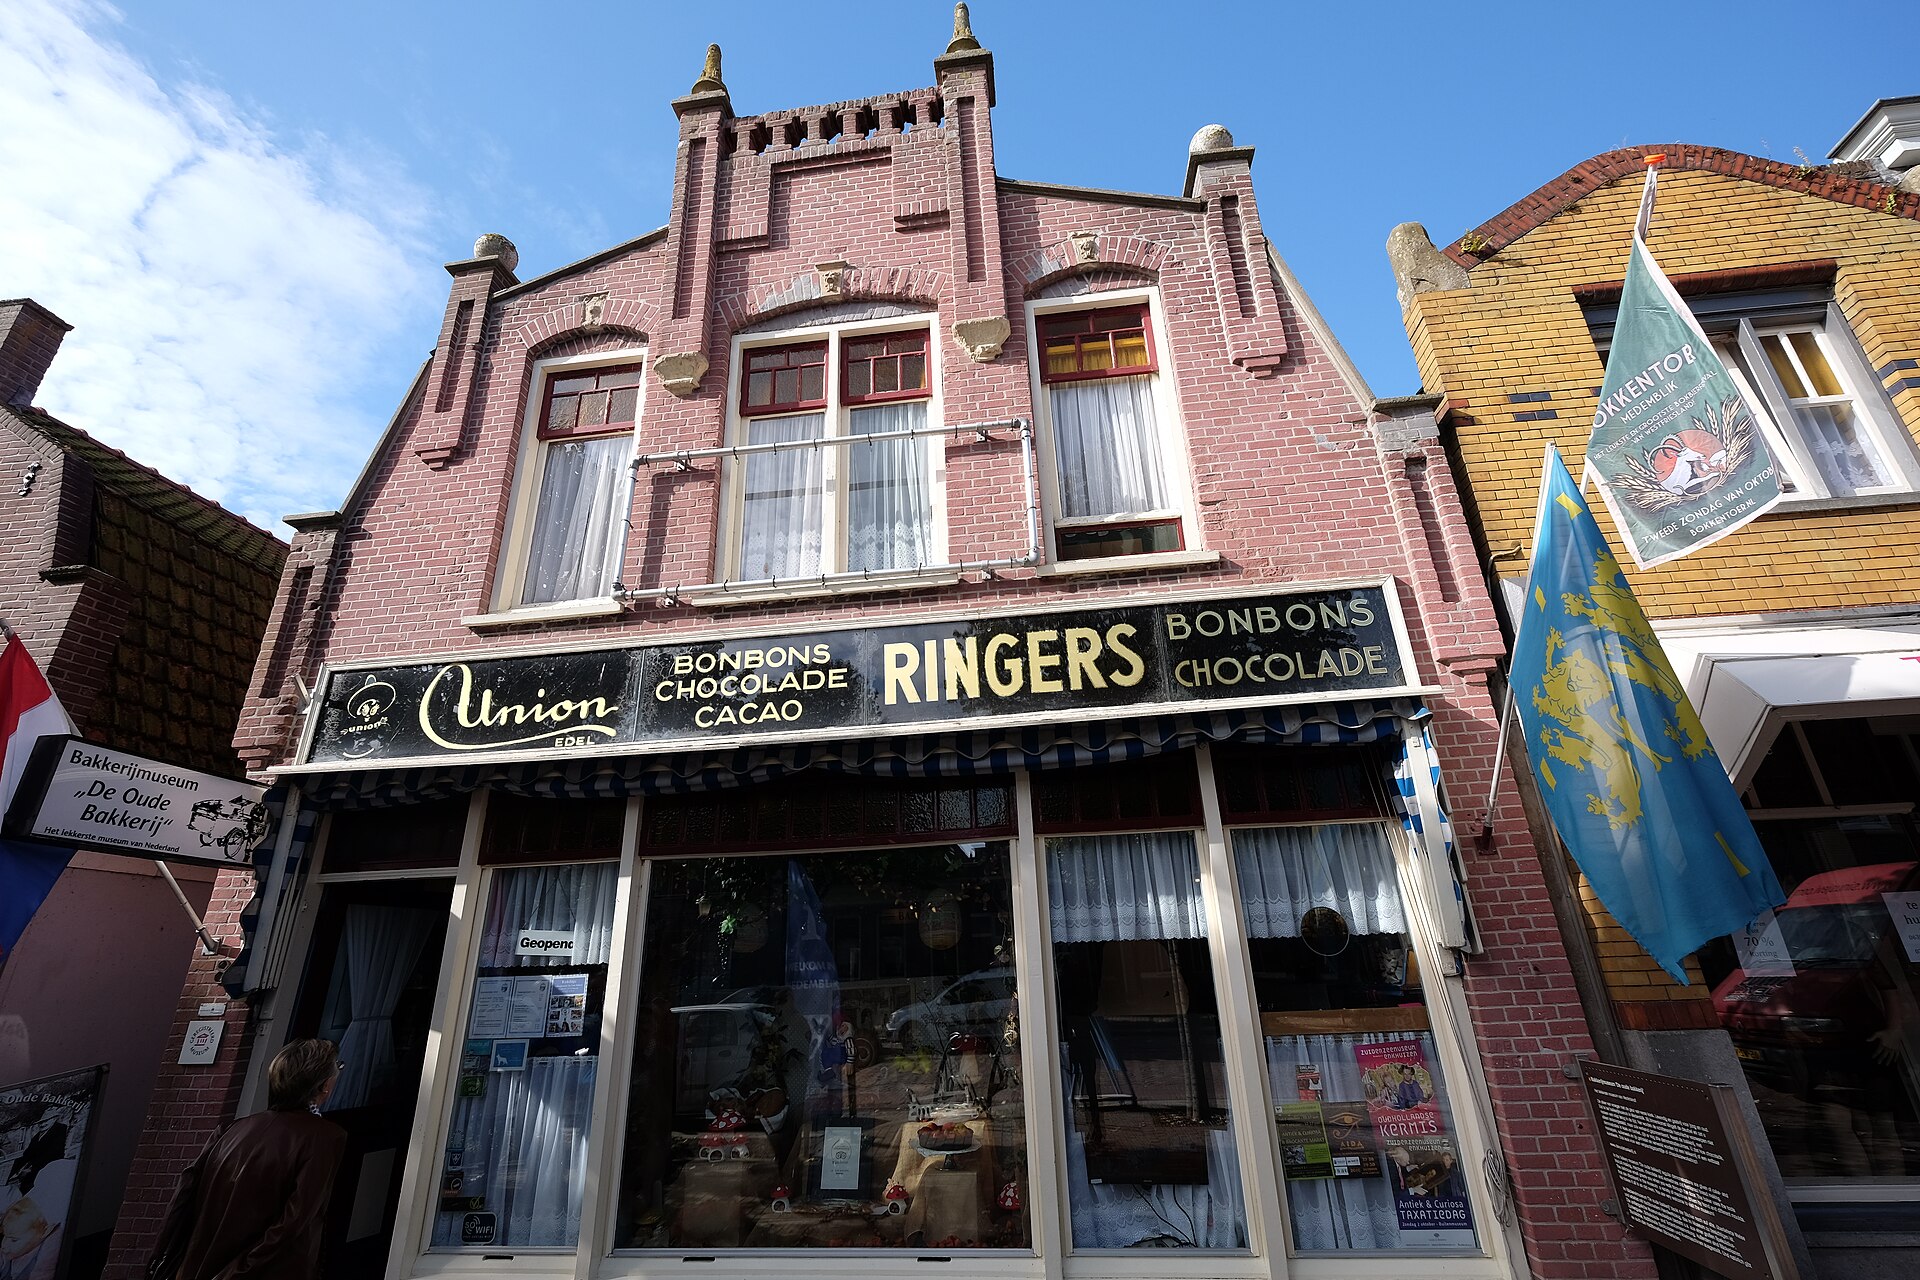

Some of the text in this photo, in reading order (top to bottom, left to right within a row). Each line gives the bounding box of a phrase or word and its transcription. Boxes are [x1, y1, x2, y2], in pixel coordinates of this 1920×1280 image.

[1620, 381, 1679, 425] MEDEMBLIK
[1593, 450, 1605, 461] HET
[1605, 434, 1630, 453] LEUKSTE
[1629, 429, 1638, 438] EN
[1638, 405, 1674, 432] GROOTSTE
[1631, 400, 1696, 444] VAN WESTFRIESLAND!
[1641, 522, 1679, 544] TWEEDE
[1679, 500, 1723, 527] ZONDAG
[1723, 487, 1745, 503] VAN
[1689, 498, 1757, 537] BOKKENTOER.NL
[1167, 598, 1376, 641] BONBONS
[673, 643, 832, 675] BONBONS
[882, 623, 1145, 706] RINGERS
[1174, 646, 1389, 688] CHOCOLADE
[654, 667, 848, 703] CHOCOLADE
[419, 663, 618, 750] Union
[693, 699, 804, 729] CACAO
[553, 735, 595, 749] EDEL
[70, 749, 199, 792] Bakkerijmuseum
[122, 787, 171, 811] Oude
[44, 826, 180, 853] Het lekkerste museum van Nederland
[1906, 902, 1919, 910] te
[1743, 936, 1759, 947] 70
[190, 1046, 210, 1056] MUSEUM
[6, 1093, 39, 1105] Oude
[1399, 1200, 1464, 1209] Antiek & Curiosa
